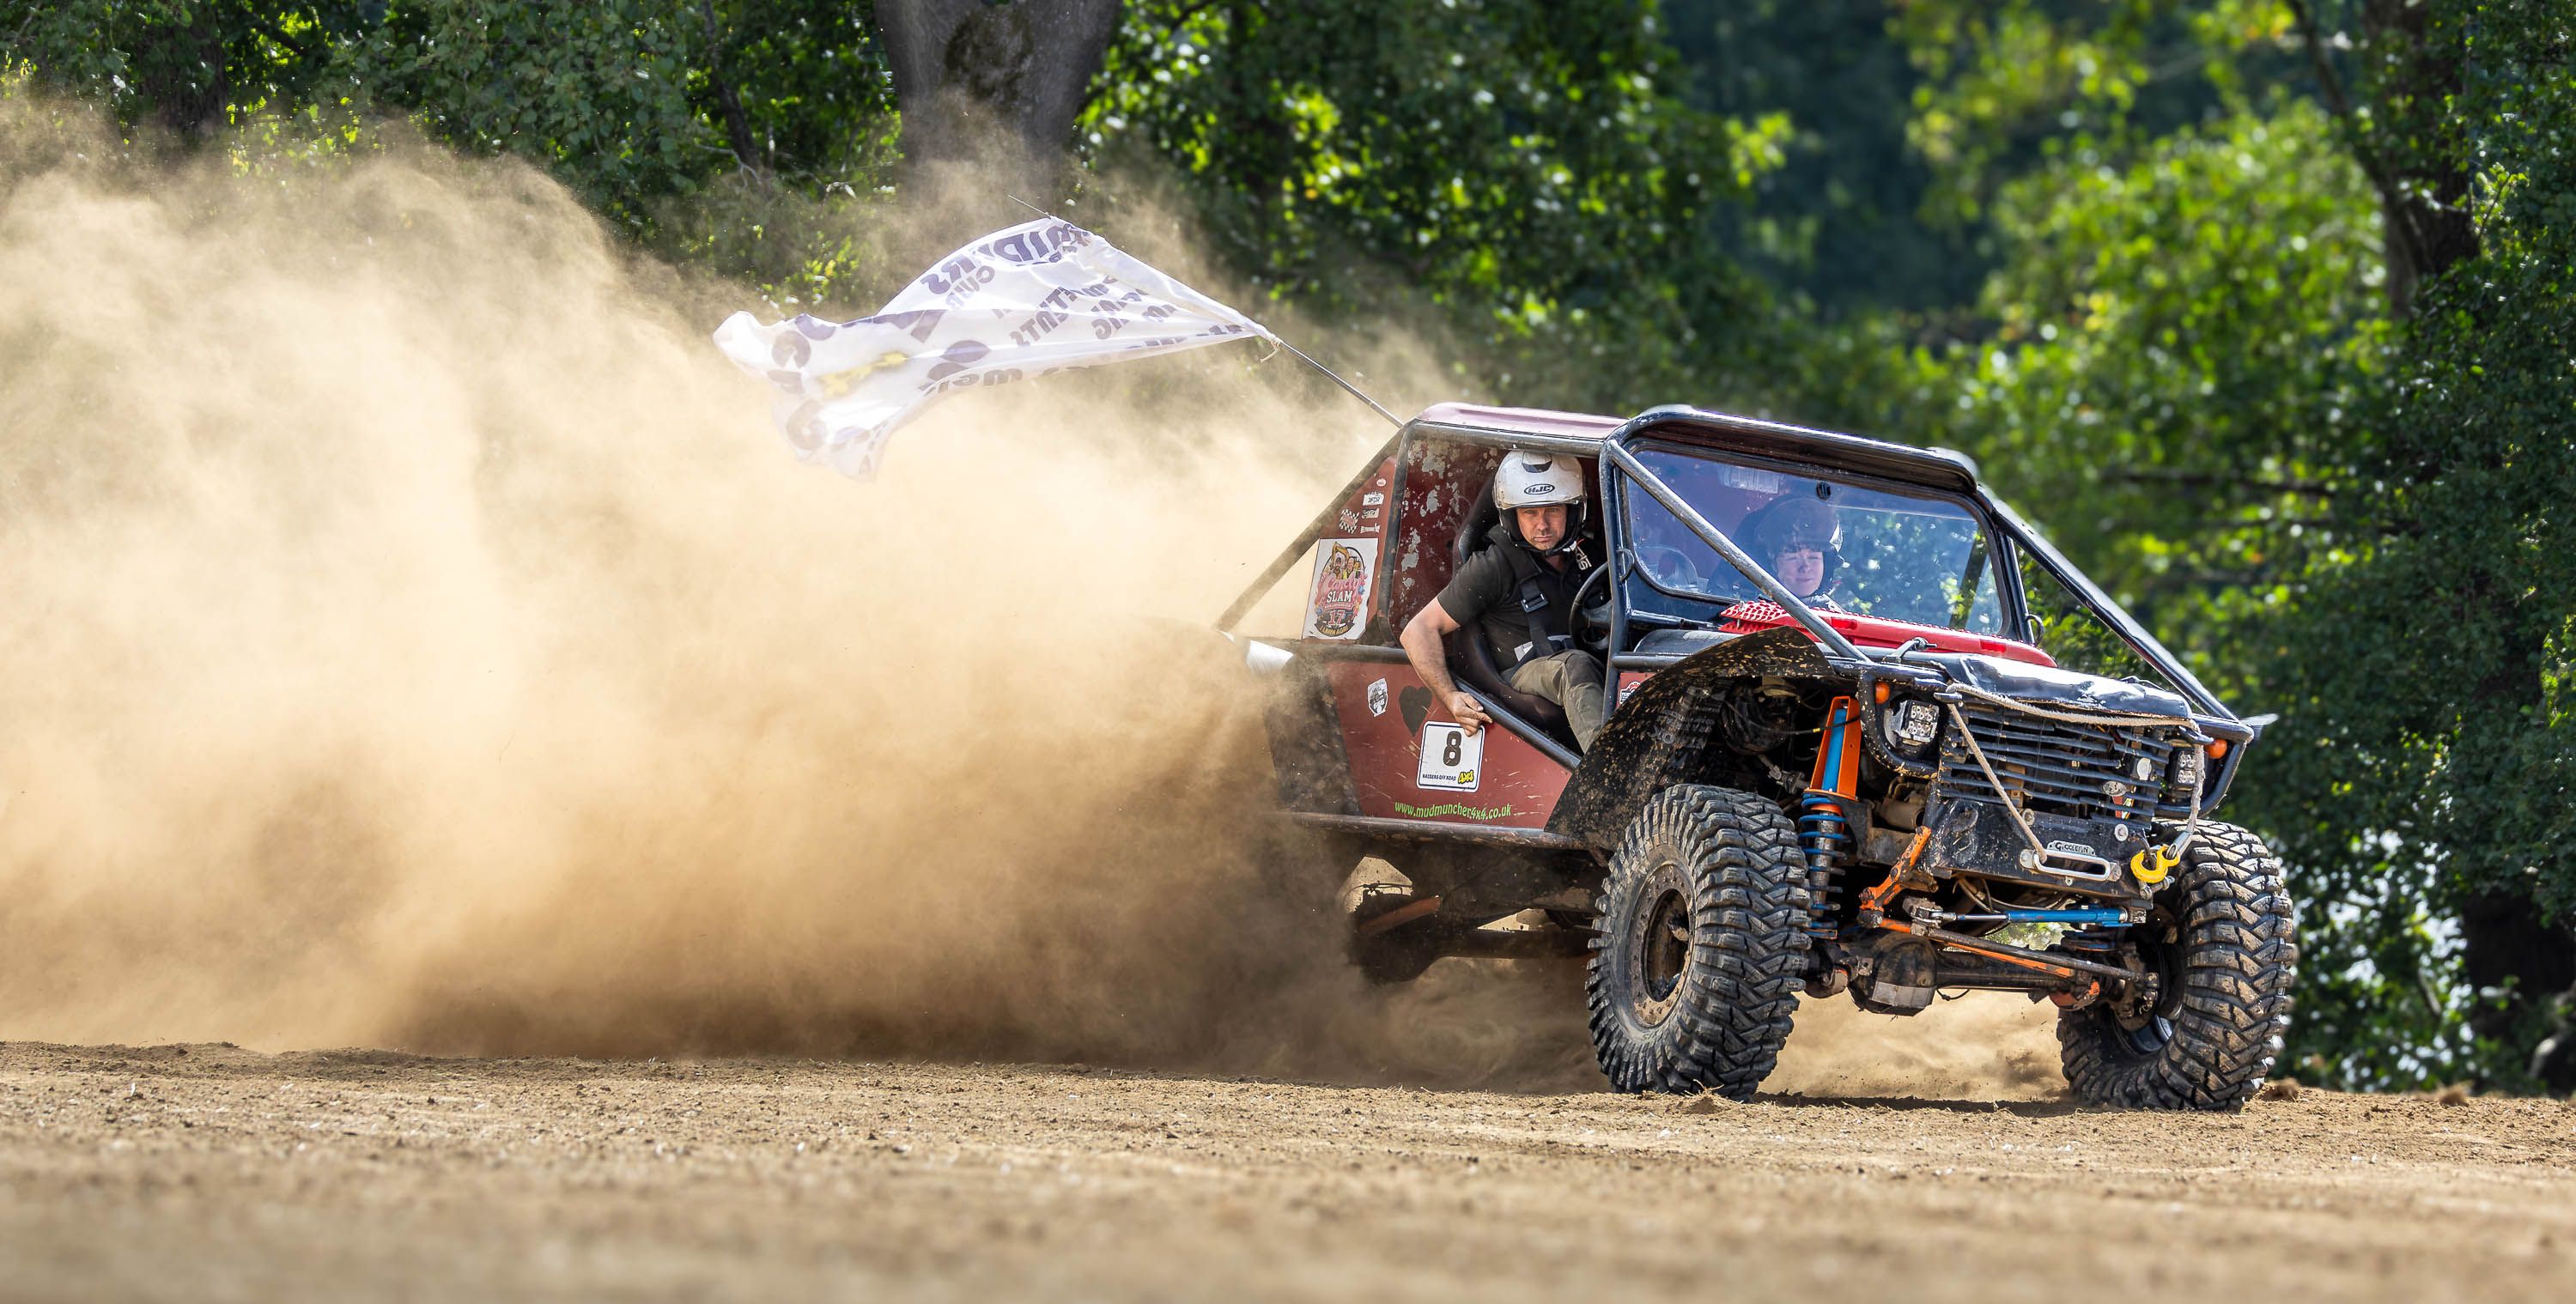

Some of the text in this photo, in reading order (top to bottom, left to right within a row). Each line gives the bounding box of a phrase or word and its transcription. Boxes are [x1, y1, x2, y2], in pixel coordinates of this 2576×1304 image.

[1327, 590, 1353, 603] SLAM
[1328, 610, 1346, 626] 17
[1443, 731, 1462, 767] 8
